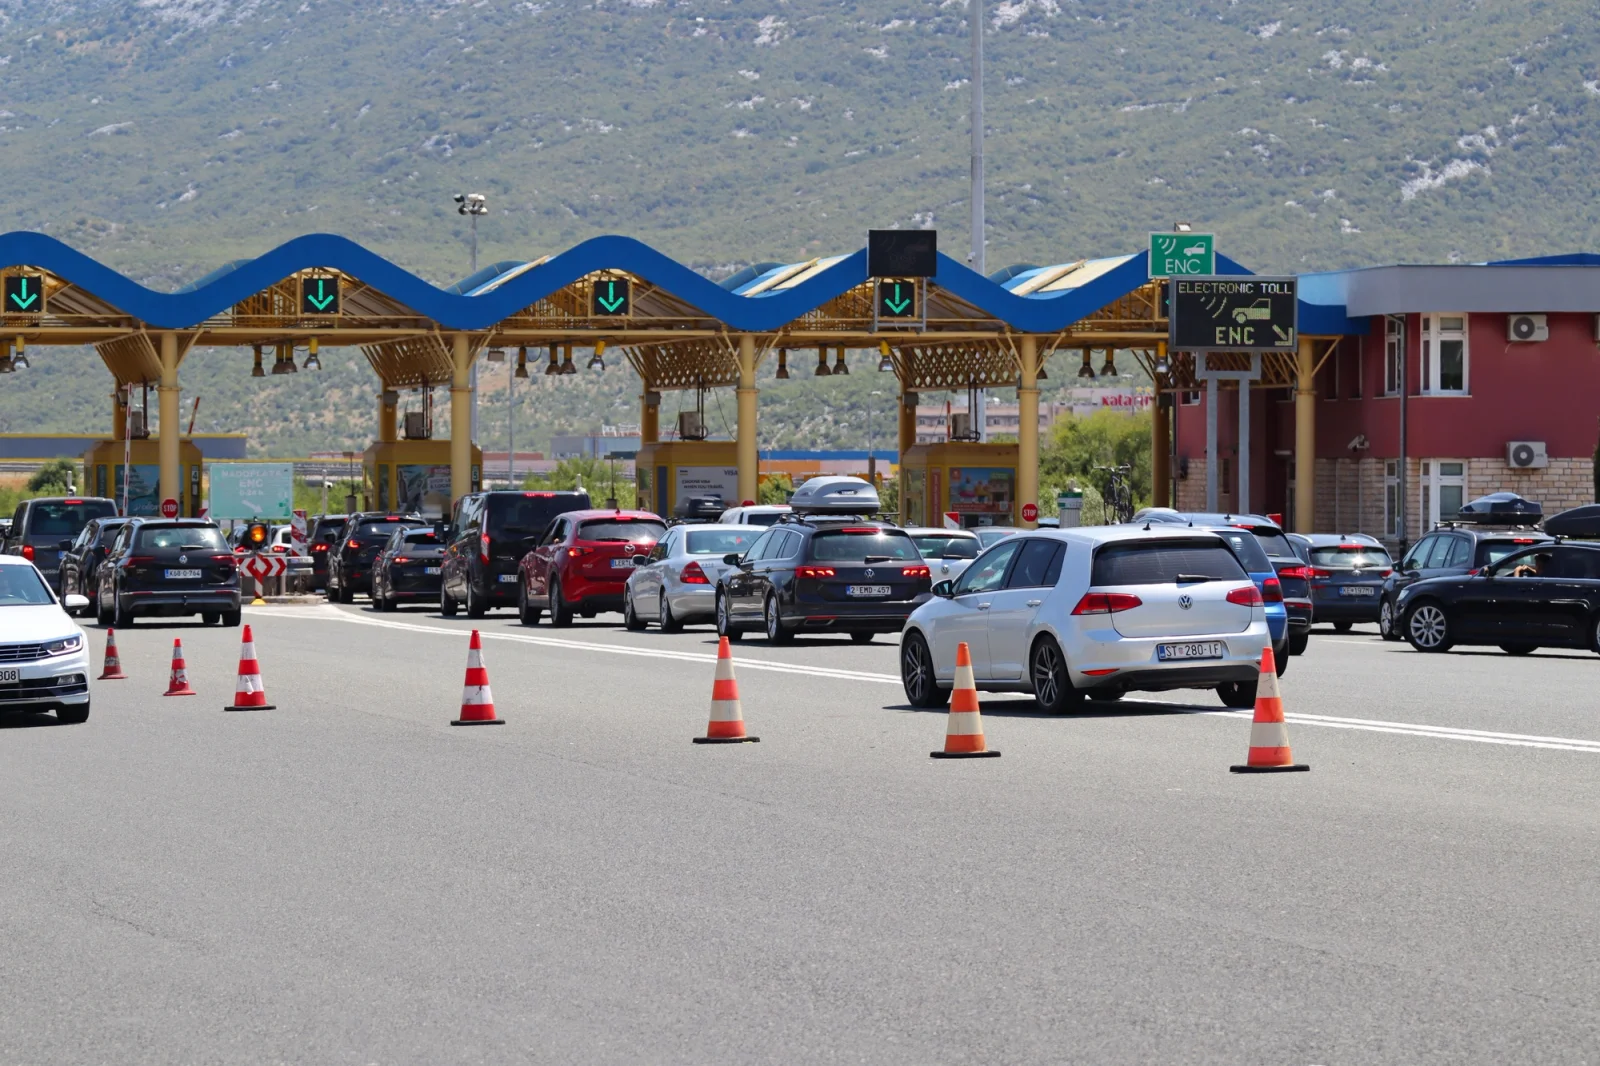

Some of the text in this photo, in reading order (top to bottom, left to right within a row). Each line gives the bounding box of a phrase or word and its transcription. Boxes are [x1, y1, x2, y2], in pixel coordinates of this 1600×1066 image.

[1165, 258, 1201, 274] ENC
[1178, 282, 1292, 294] ELECTRONIC TOLL
[1215, 326, 1255, 345] ENC
[191, 471, 198, 480] 4
[473, 472, 478, 480] 5
[163, 504, 177, 513] STOP
[1023, 509, 1036, 517] STOP
[1165, 645, 1177, 657] ST
